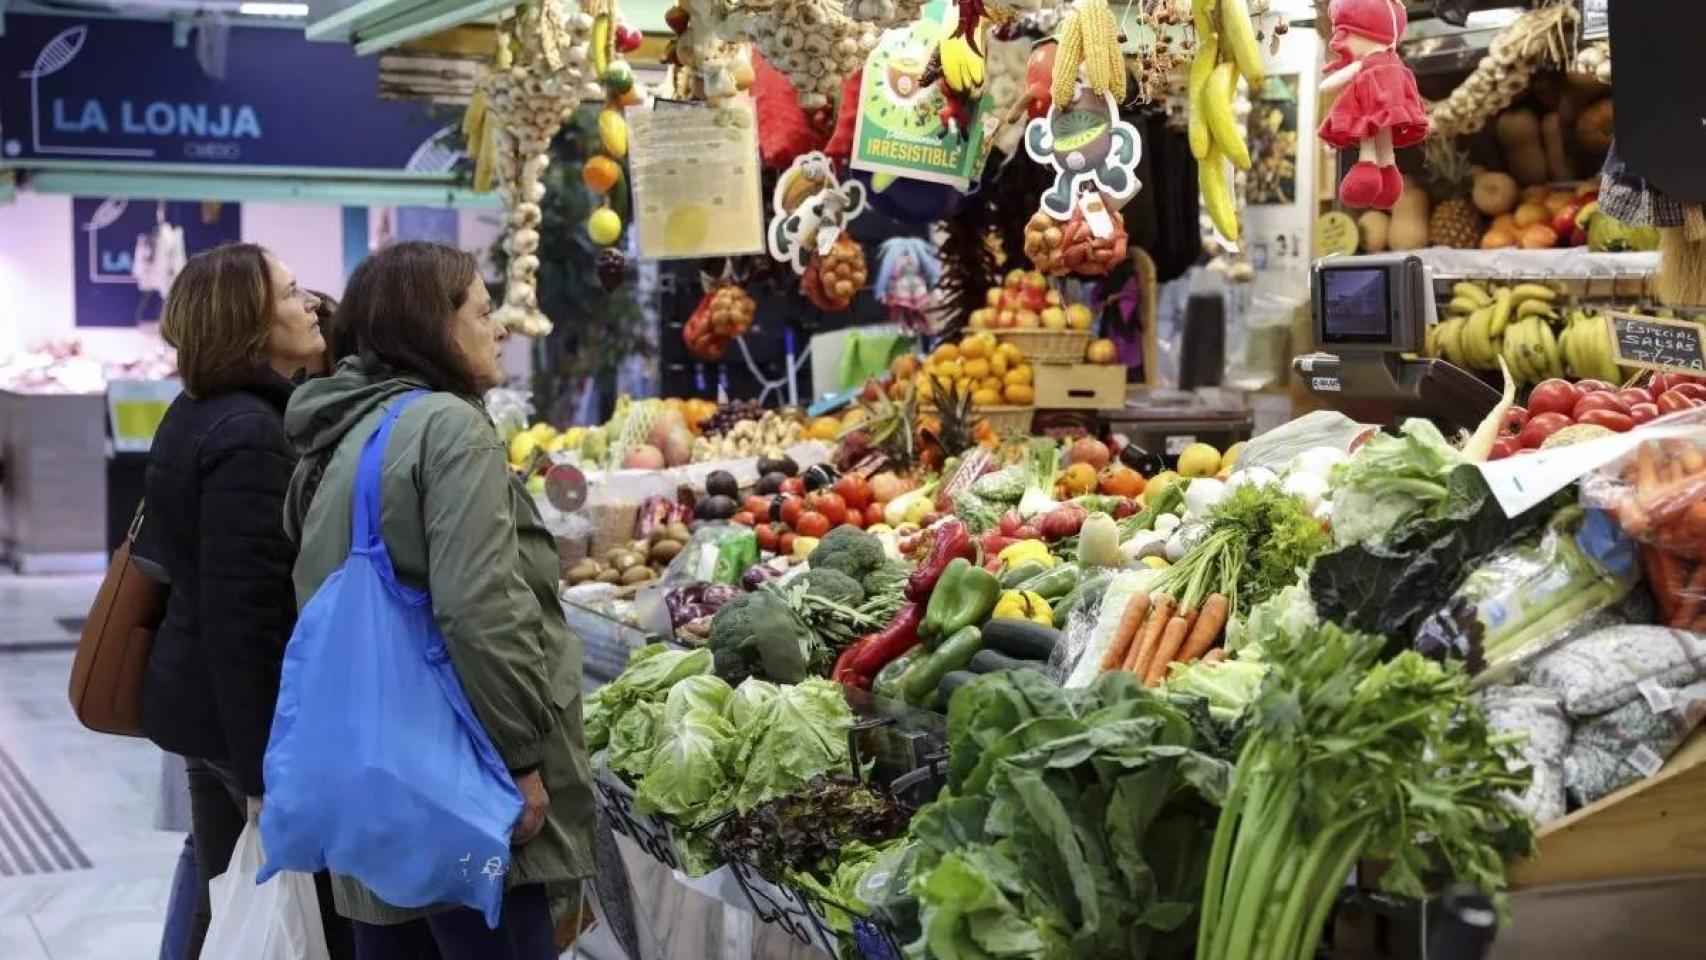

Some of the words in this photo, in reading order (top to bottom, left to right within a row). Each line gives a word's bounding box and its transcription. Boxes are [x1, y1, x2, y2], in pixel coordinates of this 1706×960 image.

[53, 98, 108, 133] LA
[121, 101, 262, 138] LONJA
[867, 138, 959, 168] IRRESISTIBLE
[1621, 335, 1695, 352] SALSAS
